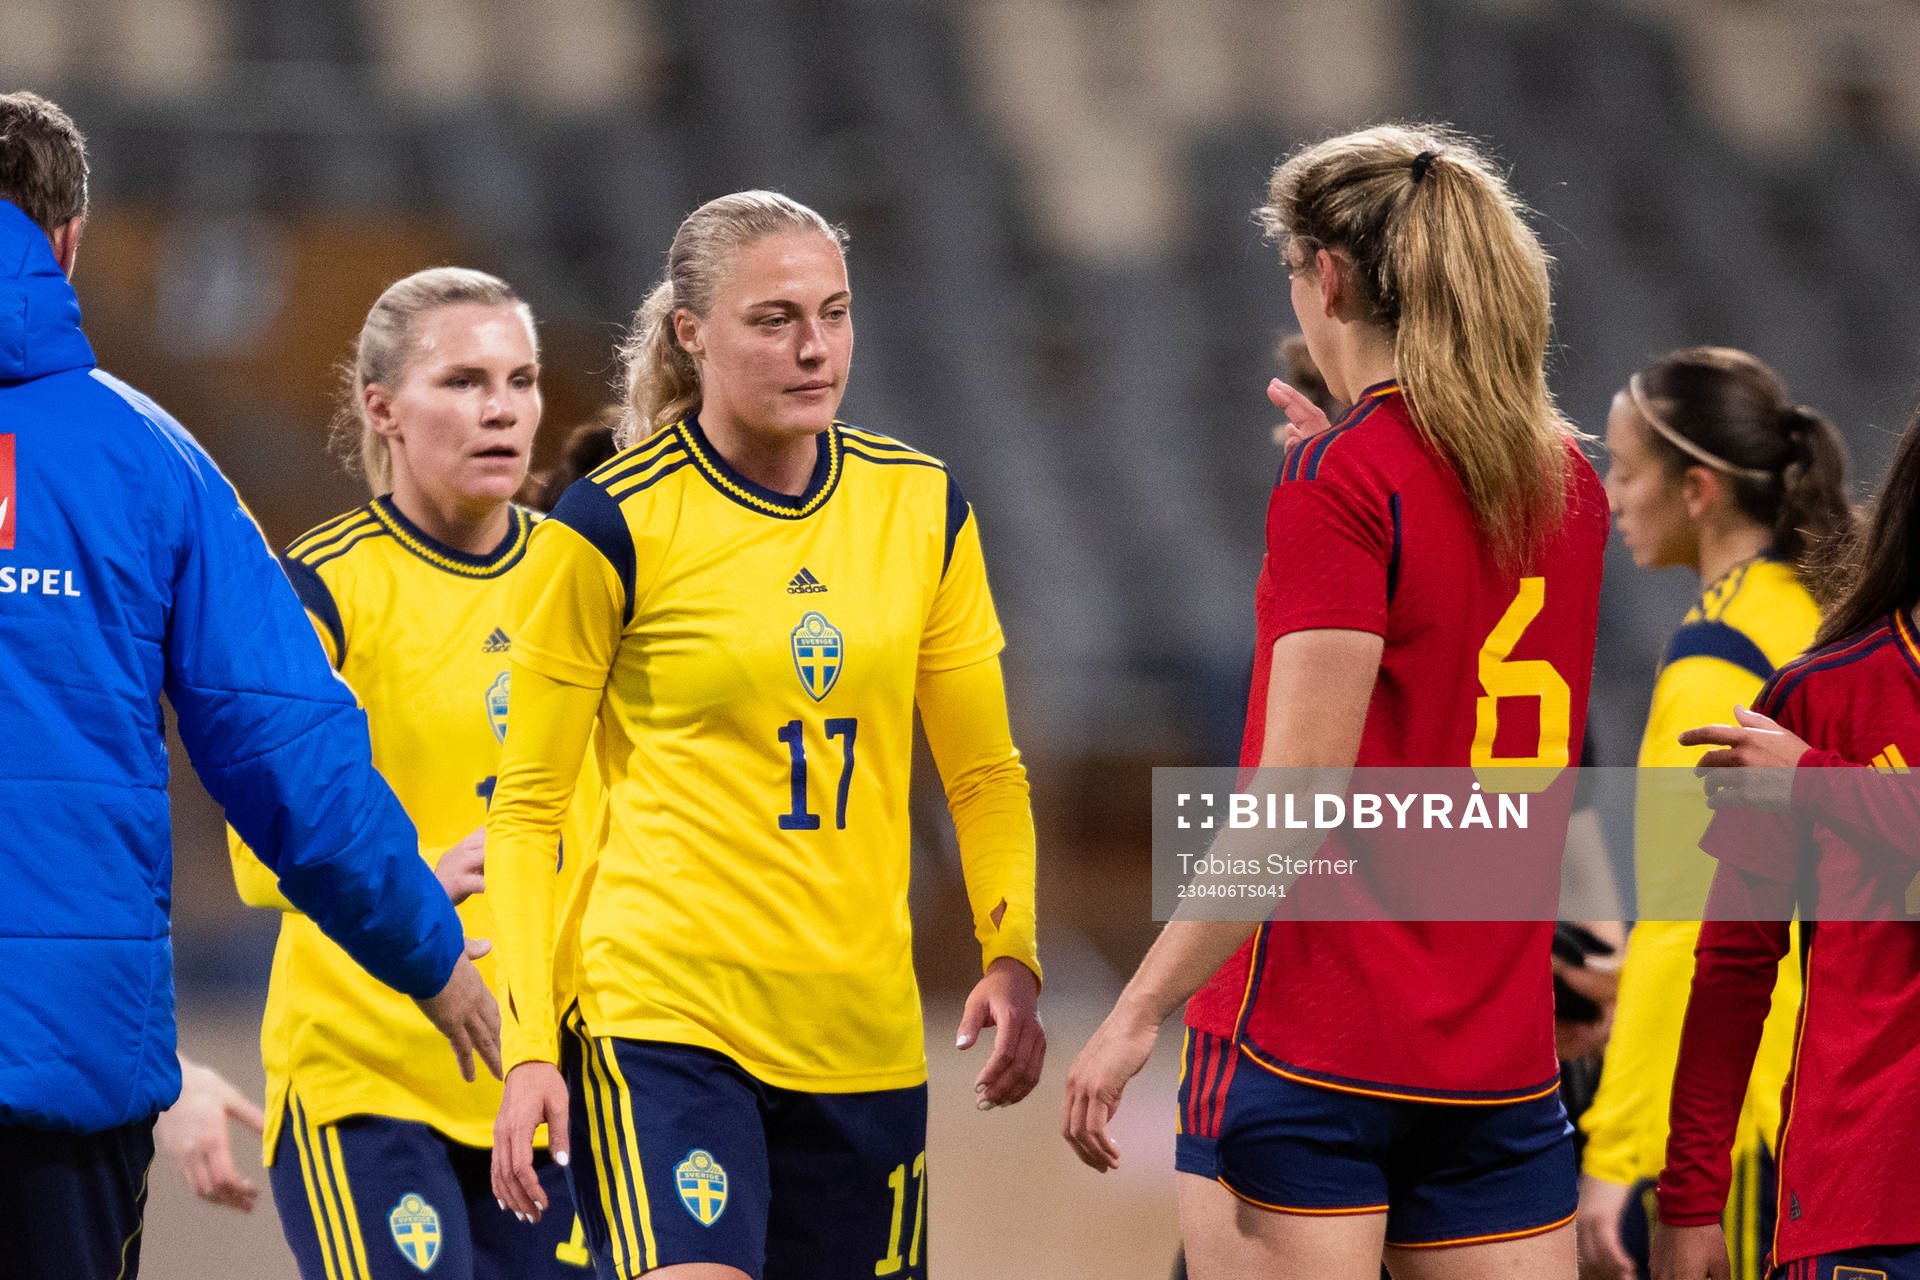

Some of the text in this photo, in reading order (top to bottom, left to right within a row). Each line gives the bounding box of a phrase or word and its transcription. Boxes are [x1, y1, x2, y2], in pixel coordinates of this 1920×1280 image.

[787, 585, 828, 594] adidas
[801, 637, 834, 645] SVERIGE
[1470, 576, 1571, 793] 6
[777, 717, 858, 830] 17
[875, 1151, 925, 1276] 17
